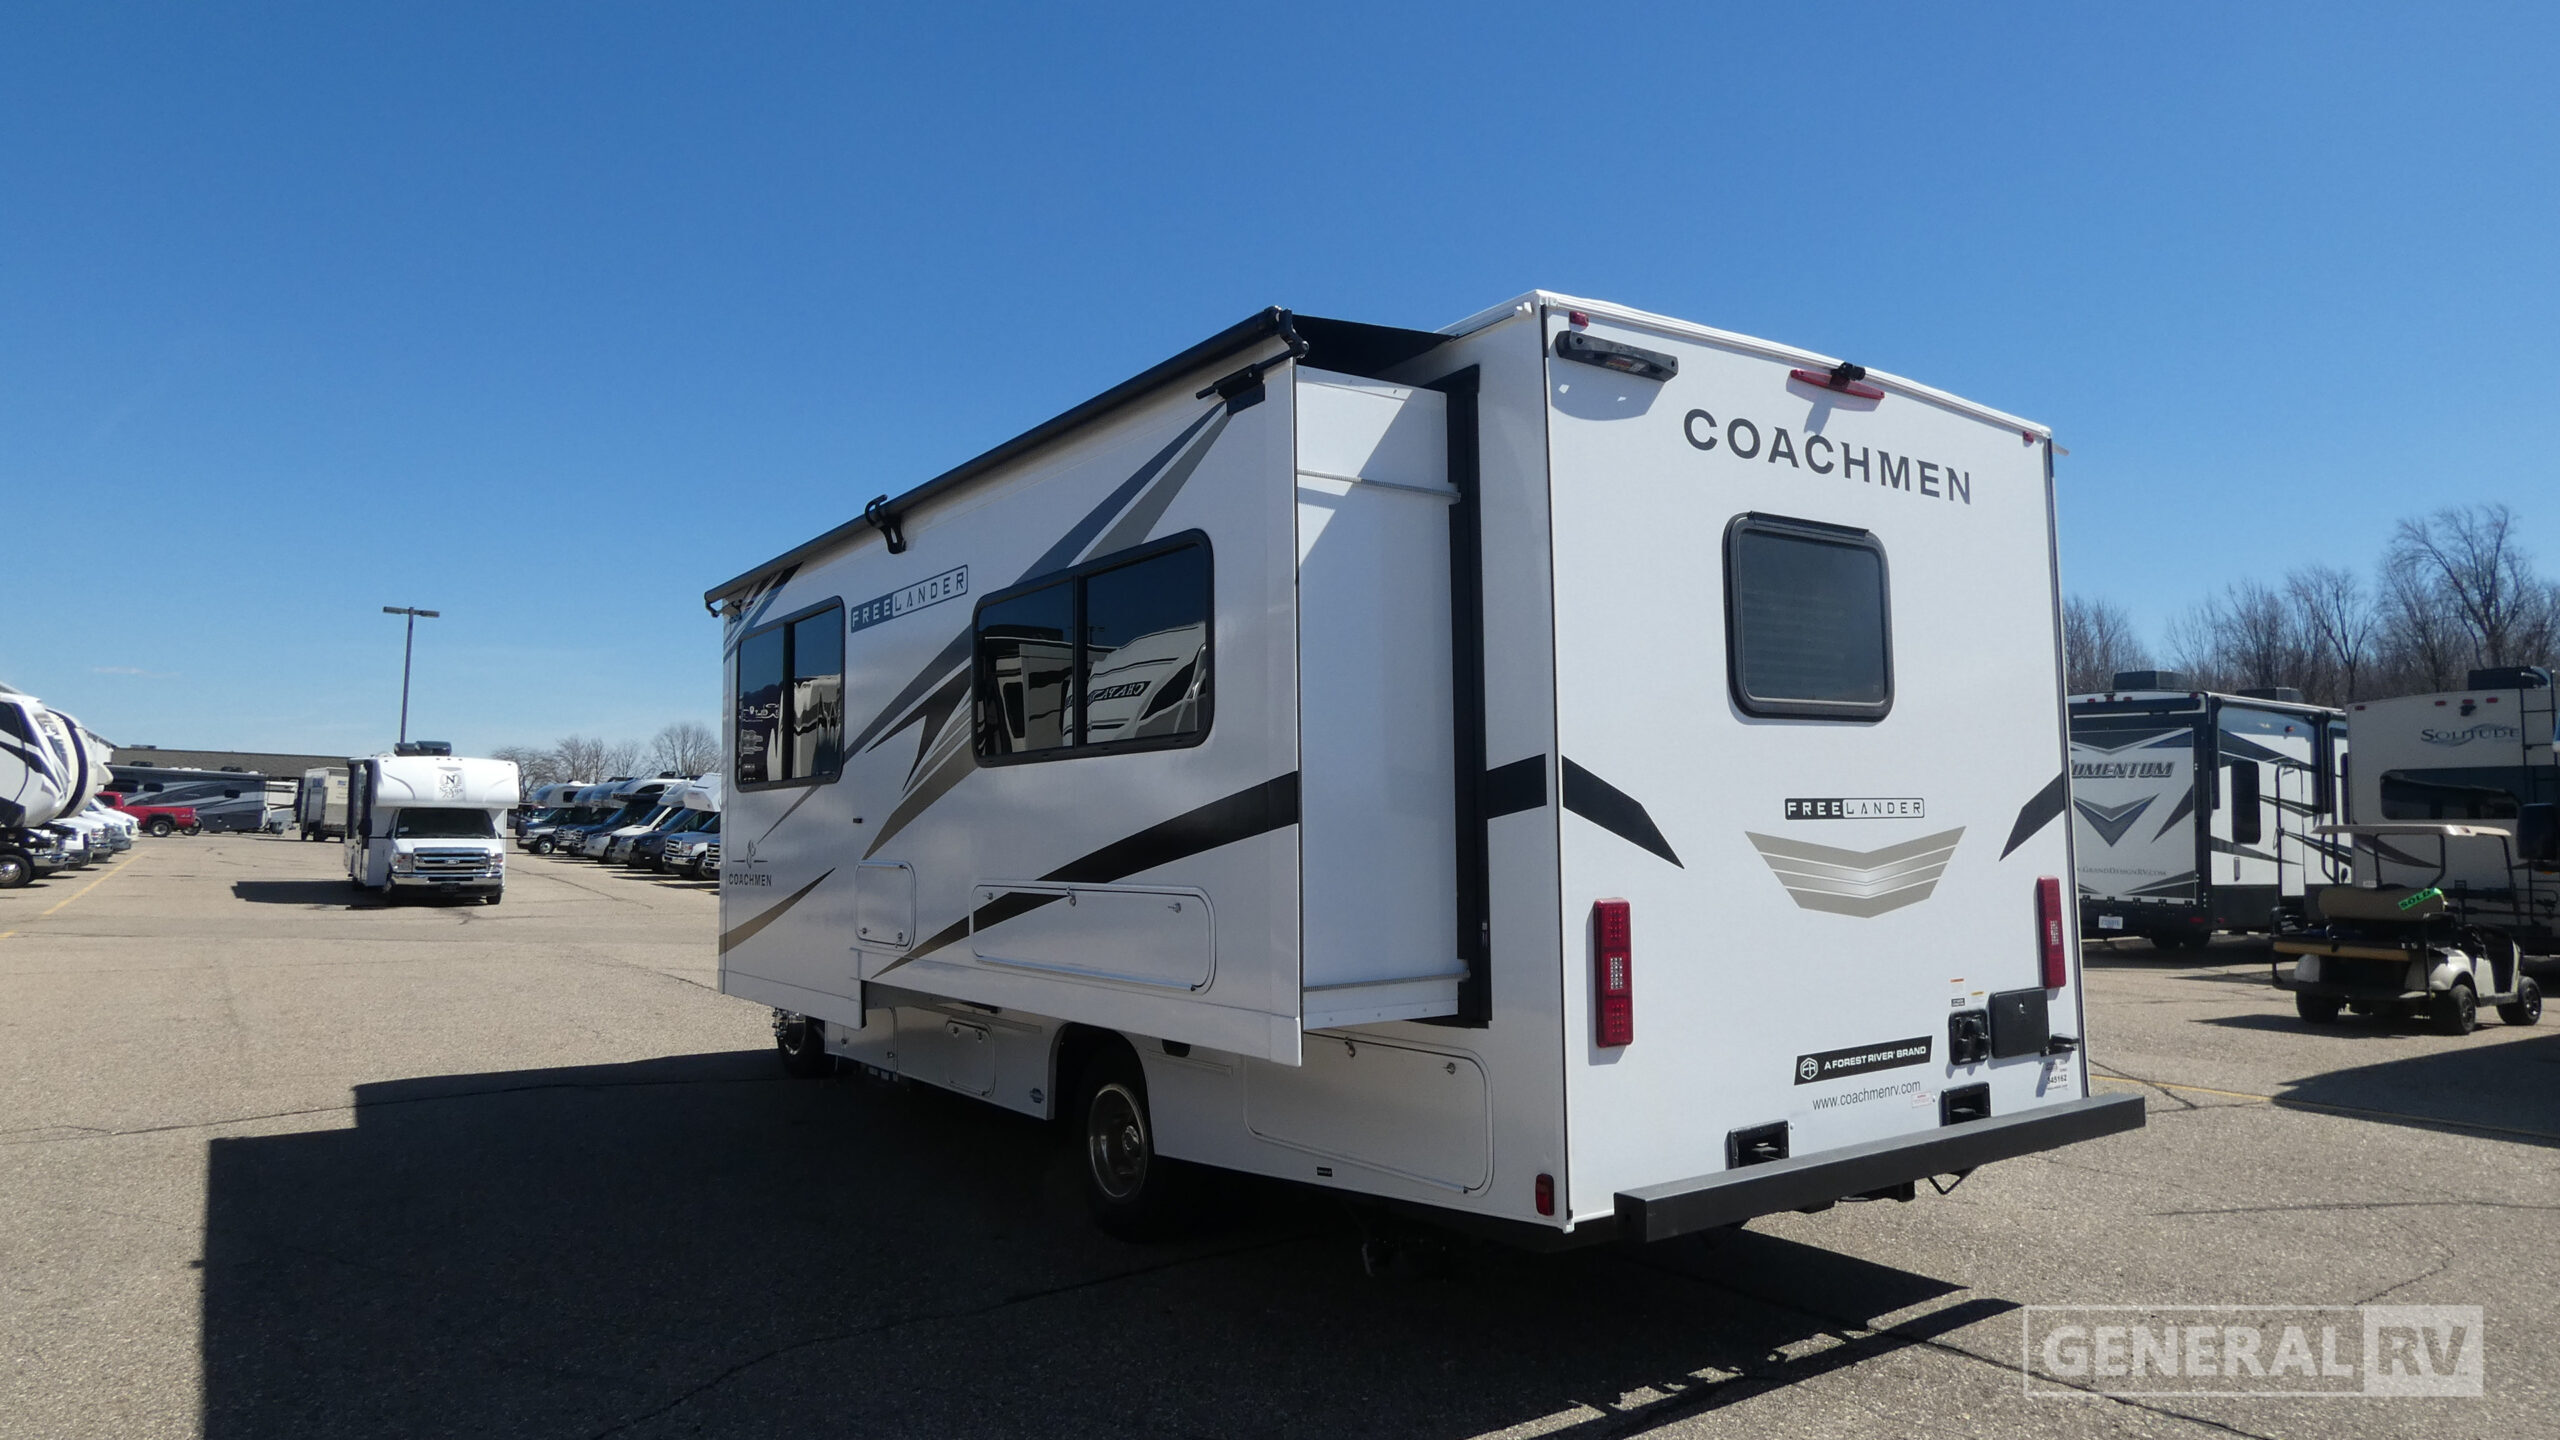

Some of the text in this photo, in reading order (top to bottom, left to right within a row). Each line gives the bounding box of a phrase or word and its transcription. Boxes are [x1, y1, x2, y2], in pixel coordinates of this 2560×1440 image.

[1684, 408, 1970, 505] COACHMEN
[852, 572, 964, 628] FREELANDER
[2421, 727, 2520, 743] SOLITUDE
[2071, 761, 2174, 778] OMENTUM
[1787, 801, 1921, 816] FREELANDER
[729, 873, 772, 886] COACHMEN
[2400, 890, 2430, 908] SOLD
[1824, 1062, 1831, 1070] A
[1832, 1055, 1866, 1068] FOREST
[1897, 1046, 1927, 1058] BRAND
[1813, 1081, 1921, 1110] www.coachmenrv.com
